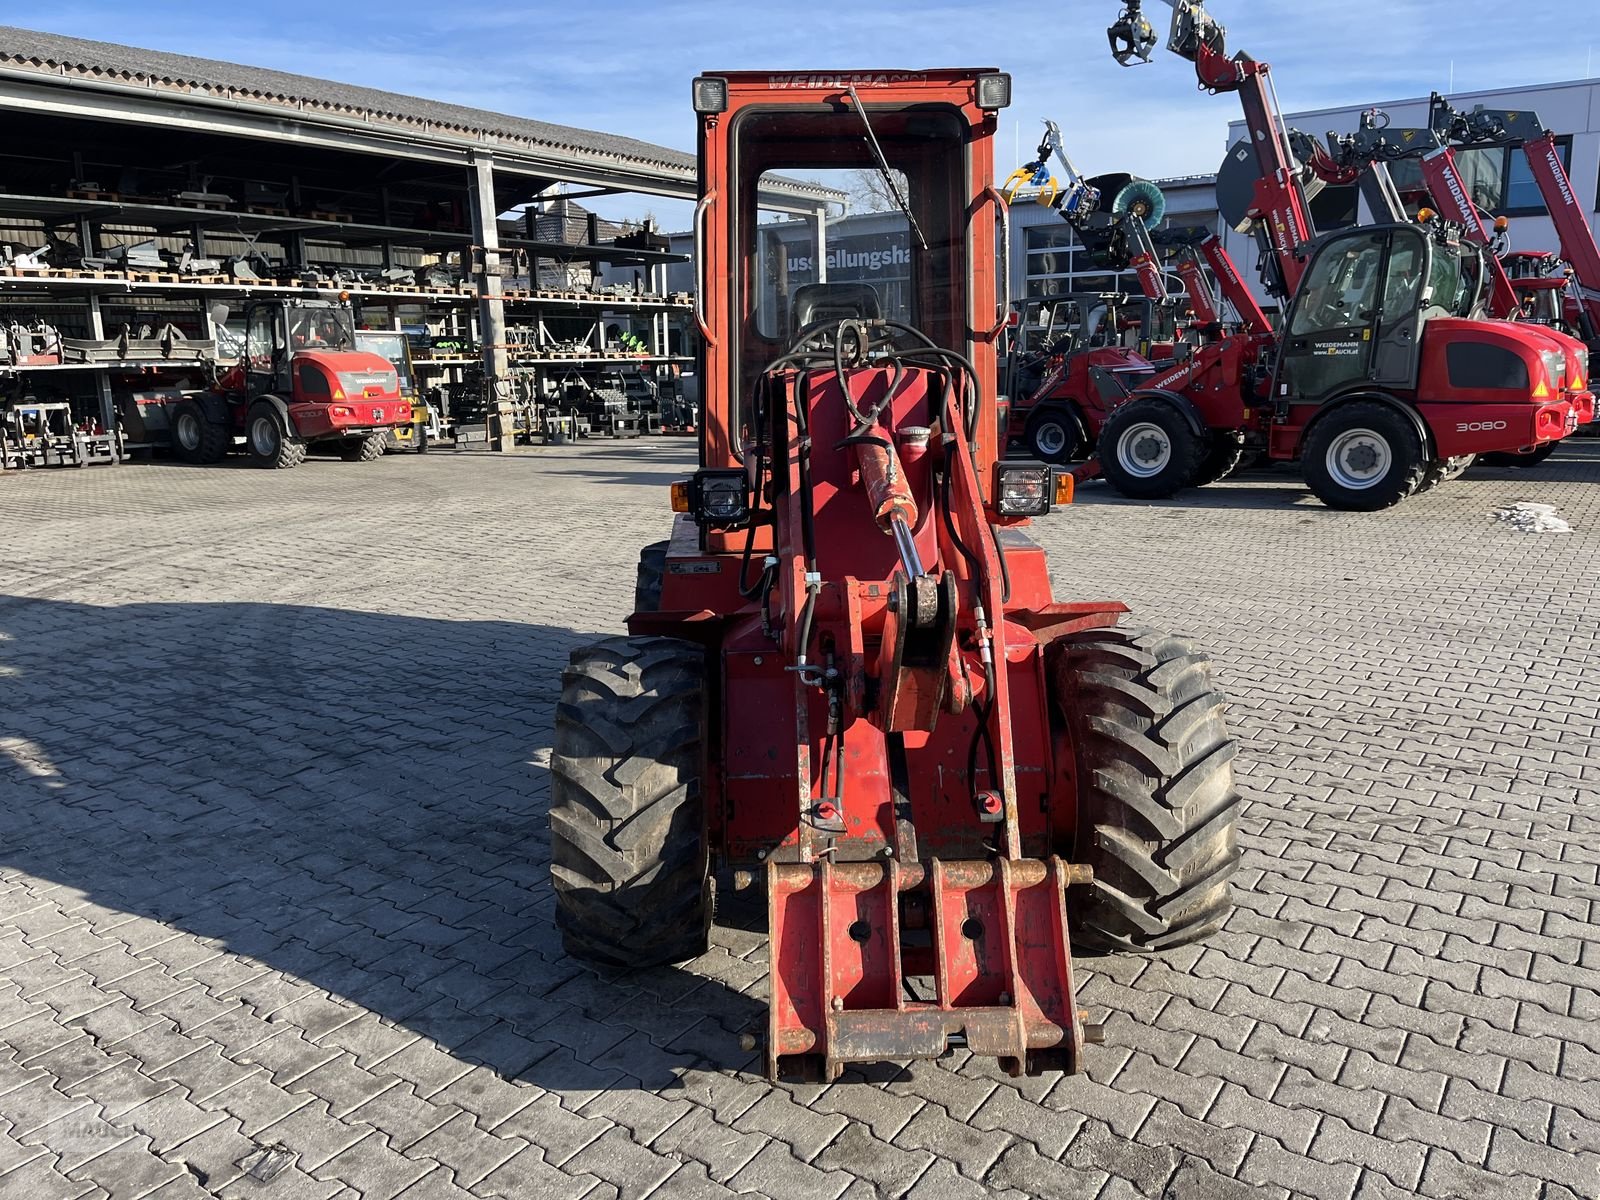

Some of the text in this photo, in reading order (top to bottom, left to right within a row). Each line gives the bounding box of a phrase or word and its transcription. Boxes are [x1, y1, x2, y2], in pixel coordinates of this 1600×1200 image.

[1545, 151, 1574, 206] WEIDEMANN
[1442, 166, 1479, 233] WEIDEMANN
[1285, 206, 1299, 247] WEIDEMAN
[787, 245, 910, 271] ussellungsha
[1212, 246, 1238, 285] WEIDEMANN
[356, 377, 387, 385] WEIDEMANN
[1456, 421, 1507, 432] 3080
